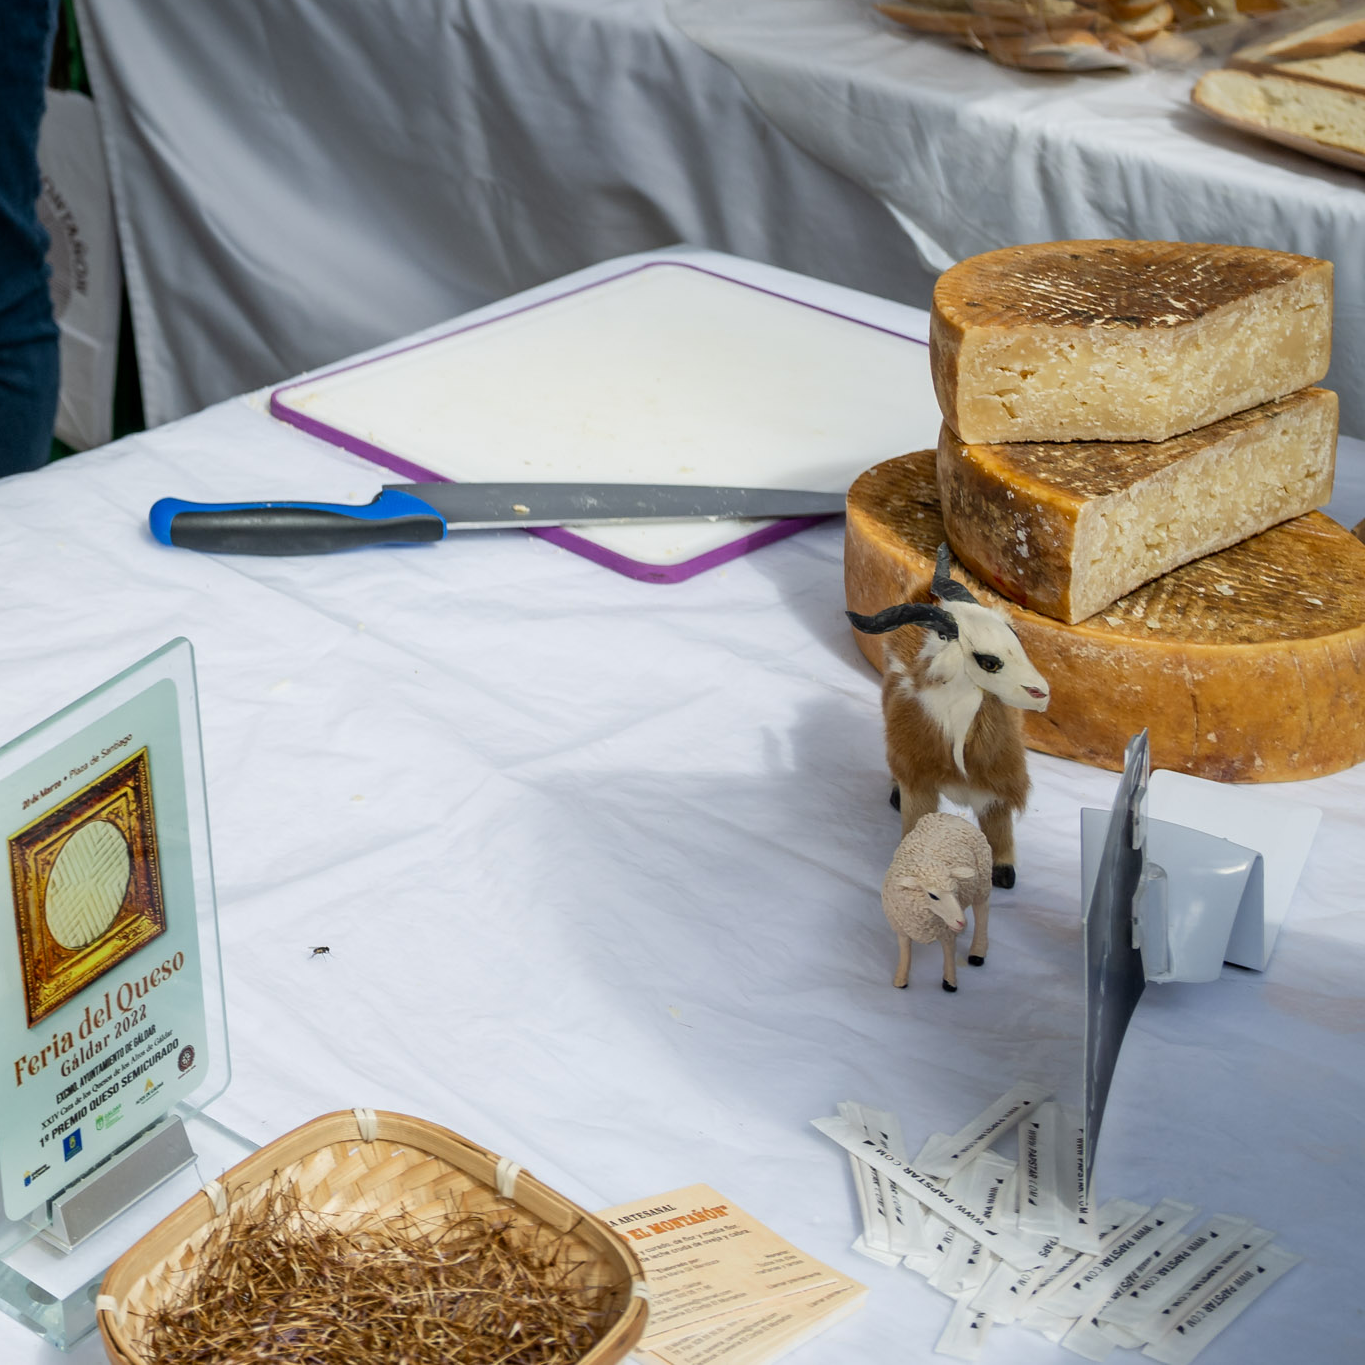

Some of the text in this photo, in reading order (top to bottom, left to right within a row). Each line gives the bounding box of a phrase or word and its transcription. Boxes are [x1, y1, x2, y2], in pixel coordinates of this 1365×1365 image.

[39, 780, 62, 797] Marzo
[69, 763, 89, 780] Plaza
[89, 755, 100, 766] de
[101, 733, 132, 759] Santiago
[13, 951, 185, 1088] Feria del Queso
[60, 1004, 148, 1078] Gáldar 2022
[79, 1047, 125, 1087] AYUNTAMIENTO
[125, 1041, 133, 1052] DE
[133, 1024, 157, 1047] GÁLDAR
[40, 1110, 61, 1131] XXIV
[74, 1096, 83, 1105] de
[83, 1090, 92, 1101] los
[91, 1074, 114, 1094] Quesos
[113, 1068, 121, 1078] de
[121, 1061, 130, 1072] los
[130, 1049, 147, 1064] Altos
[146, 1042, 154, 1052] de
[51, 1105, 88, 1140] PREMIO
[89, 1082, 120, 1112] QUESO
[121, 1038, 180, 1088] SEMICURADO
[874, 1147, 903, 1168] COM
[1027, 1149, 1038, 1179] PAPSTAR
[902, 1165, 955, 1205] PAPSTAR
[617, 1203, 678, 1225] ARTESANAL
[626, 1226, 654, 1241] EL
[1098, 1238, 1136, 1268] PAPSTAR
[1154, 1250, 1192, 1278] PAPSTAR
[1201, 1284, 1238, 1314] PAPSTAR
